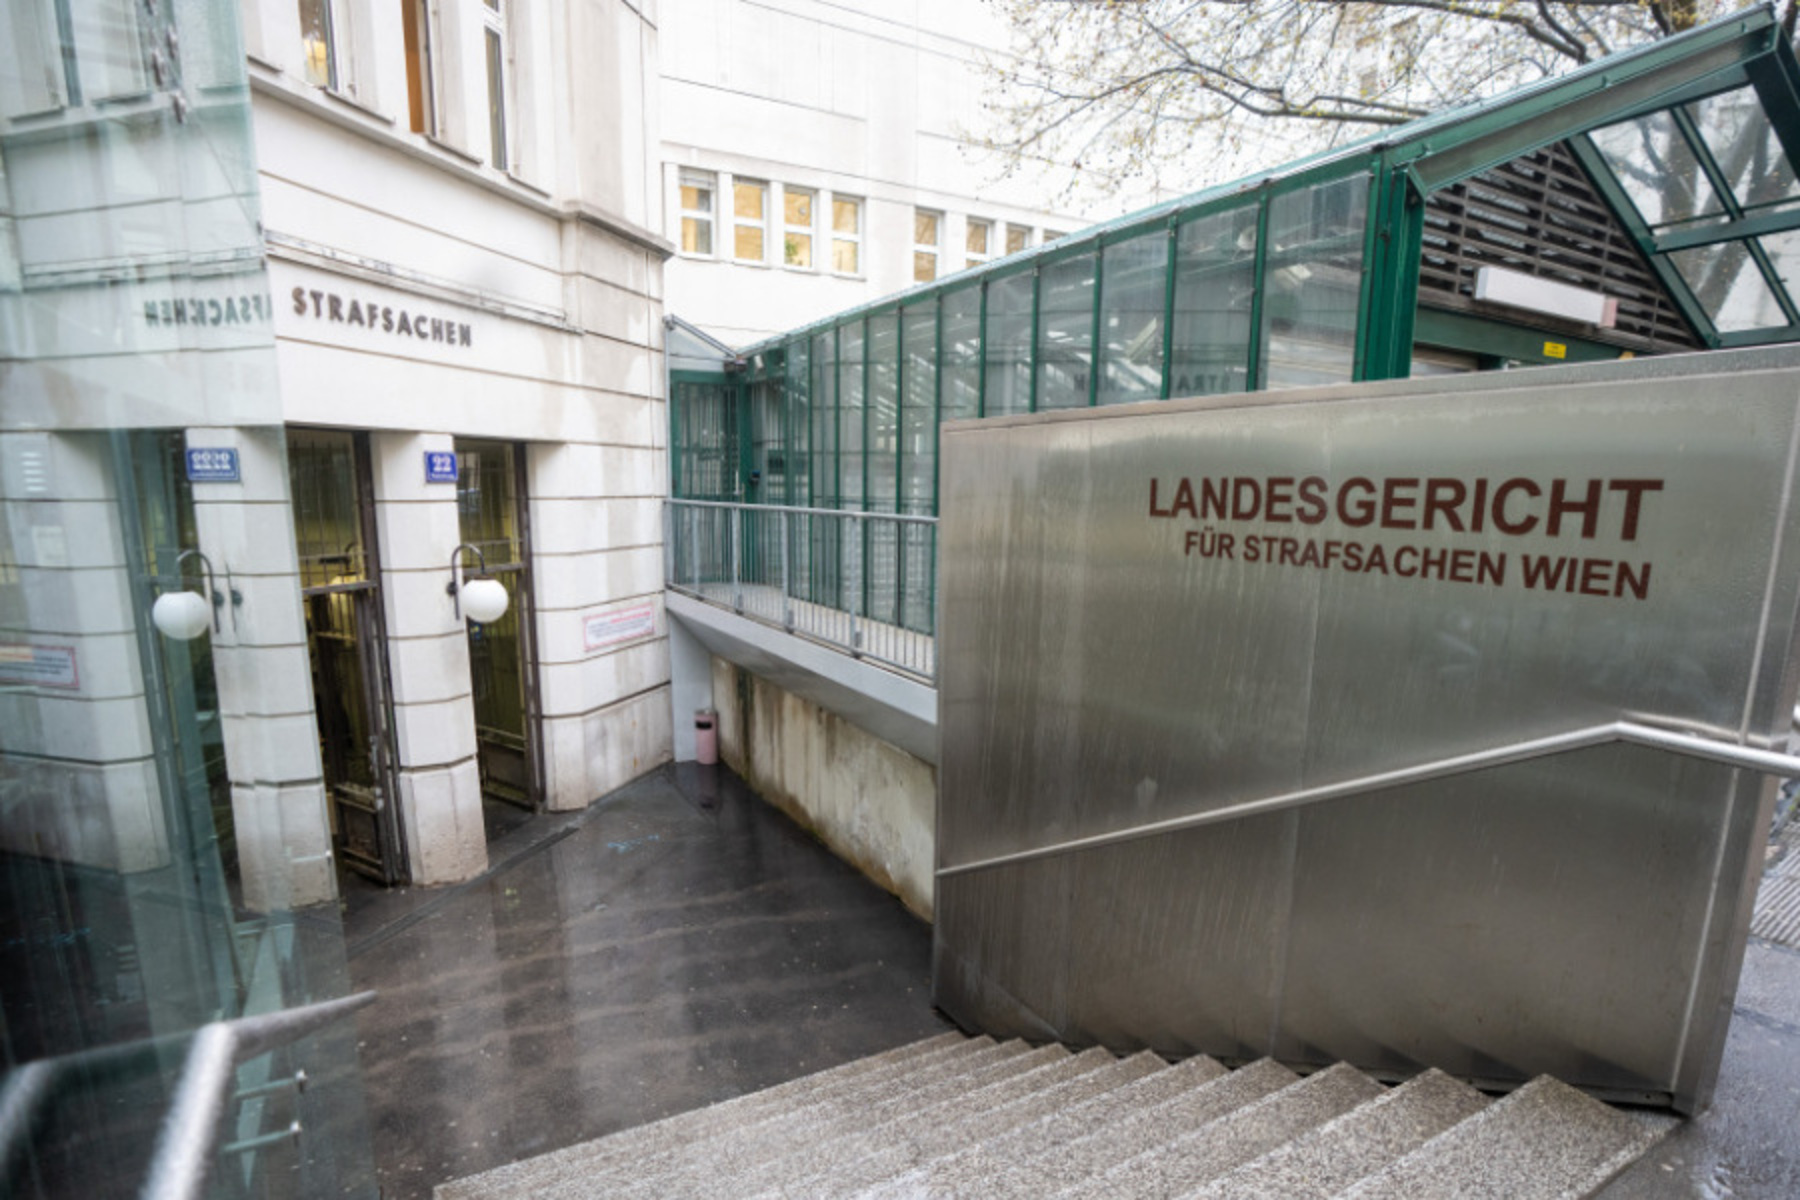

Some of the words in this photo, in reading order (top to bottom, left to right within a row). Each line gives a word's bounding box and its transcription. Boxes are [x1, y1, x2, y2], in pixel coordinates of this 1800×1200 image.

[292, 286, 472, 347] STRAFSACHEN
[432, 455, 452, 472] 22
[1150, 476, 1664, 541] LANDESGERICHT
[1185, 526, 1235, 559] FÜR
[1243, 535, 1506, 587] STRAFSACHEN
[1522, 554, 1652, 600] WIEN
